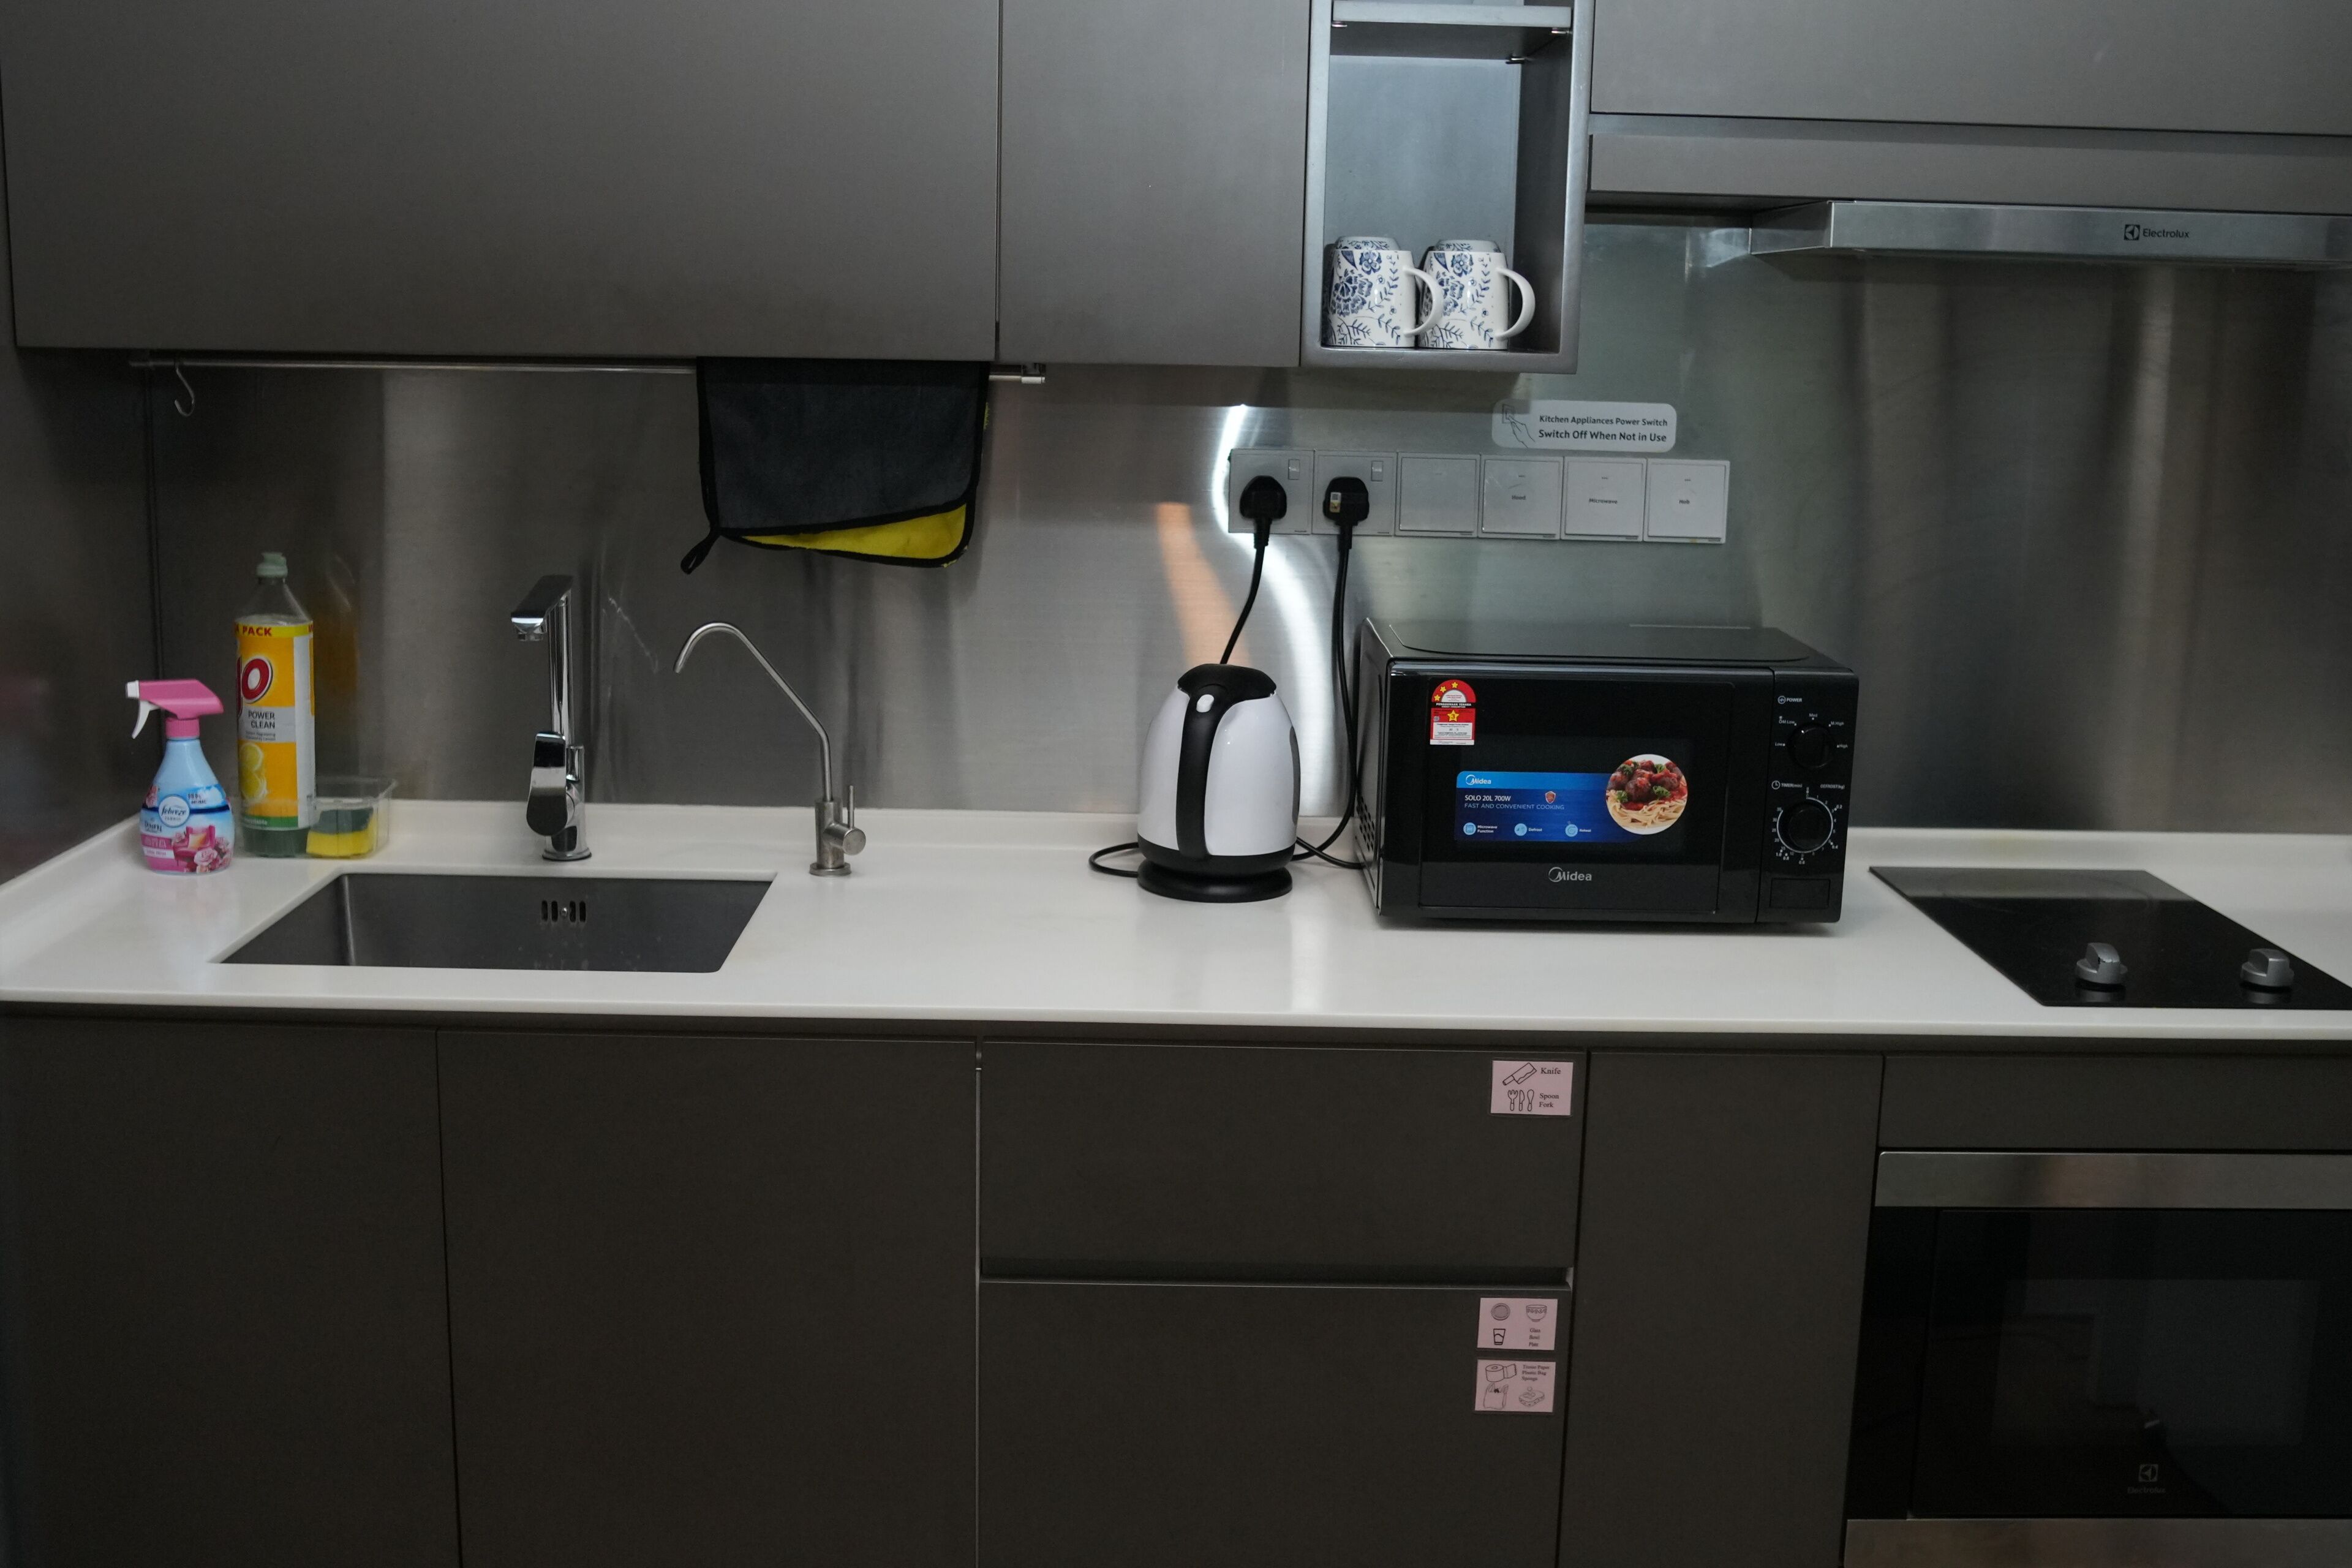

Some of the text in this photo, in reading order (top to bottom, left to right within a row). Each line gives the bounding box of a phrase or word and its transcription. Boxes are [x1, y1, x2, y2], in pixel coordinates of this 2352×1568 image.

[2143, 228, 2190, 238] Electrolux
[1570, 417, 1613, 425] Appliances
[1539, 429, 1570, 439] Switch
[1572, 431, 1588, 439] Off
[1619, 432, 1636, 441] Not
[243, 626, 272, 636] PACK
[248, 710, 275, 720] POWER
[251, 720, 275, 729] CLEAN
[1466, 774, 1491, 785] Midea
[162, 805, 186, 816] febreze
[1548, 866, 1593, 882] Midea
